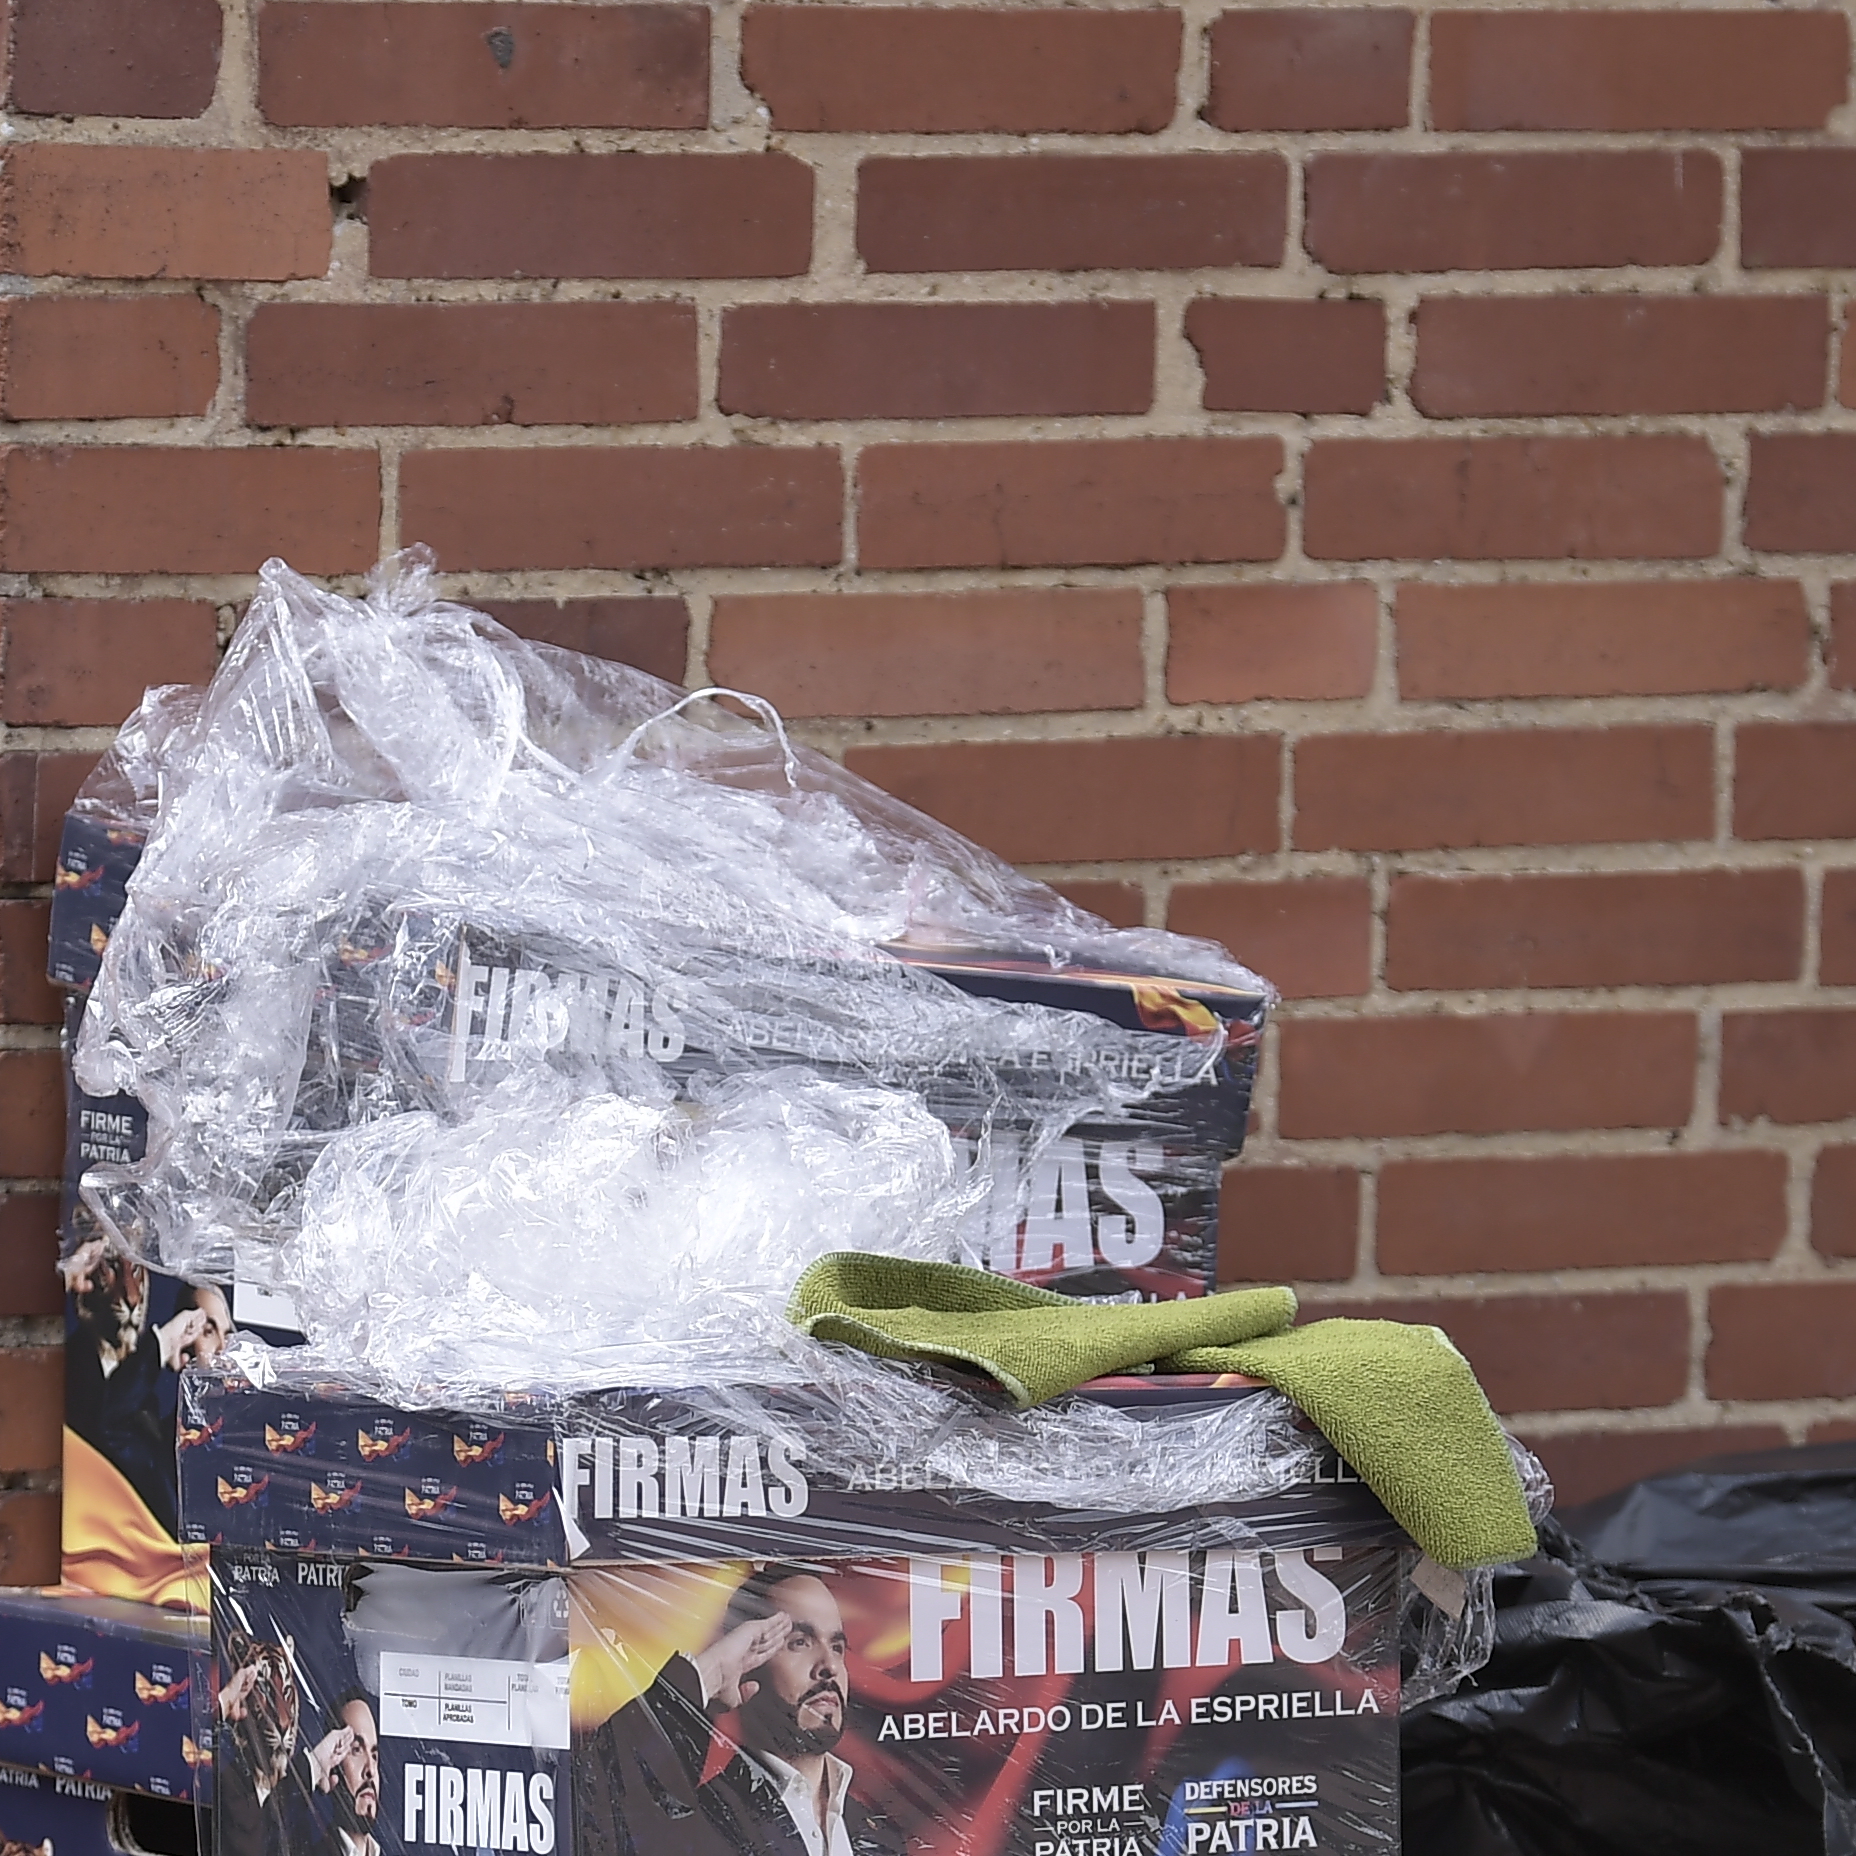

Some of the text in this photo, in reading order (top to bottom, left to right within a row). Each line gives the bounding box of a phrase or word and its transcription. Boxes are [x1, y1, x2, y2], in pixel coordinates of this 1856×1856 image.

[81, 1110, 133, 1135] FIRME
[81, 1142, 131, 1162] PATRIA
[561, 1435, 810, 1521] FIRMAS
[234, 1562, 348, 1587] PATRIA PATRI
[908, 1548, 1346, 1683] FIRMAS
[876, 1688, 1381, 1743] ABELARDO DE LA ESPRIELLA
[54, 1776, 112, 1800] PATRIA
[1032, 1783, 1144, 1817] FIRME
[1185, 1775, 1317, 1801] DEFENSORES
[403, 1762, 555, 1855] FIRMAS
[1229, 1801, 1273, 1817] DE LA
[1057, 1817, 1120, 1835] POR LA
[1187, 1816, 1318, 1855] PATRIA
